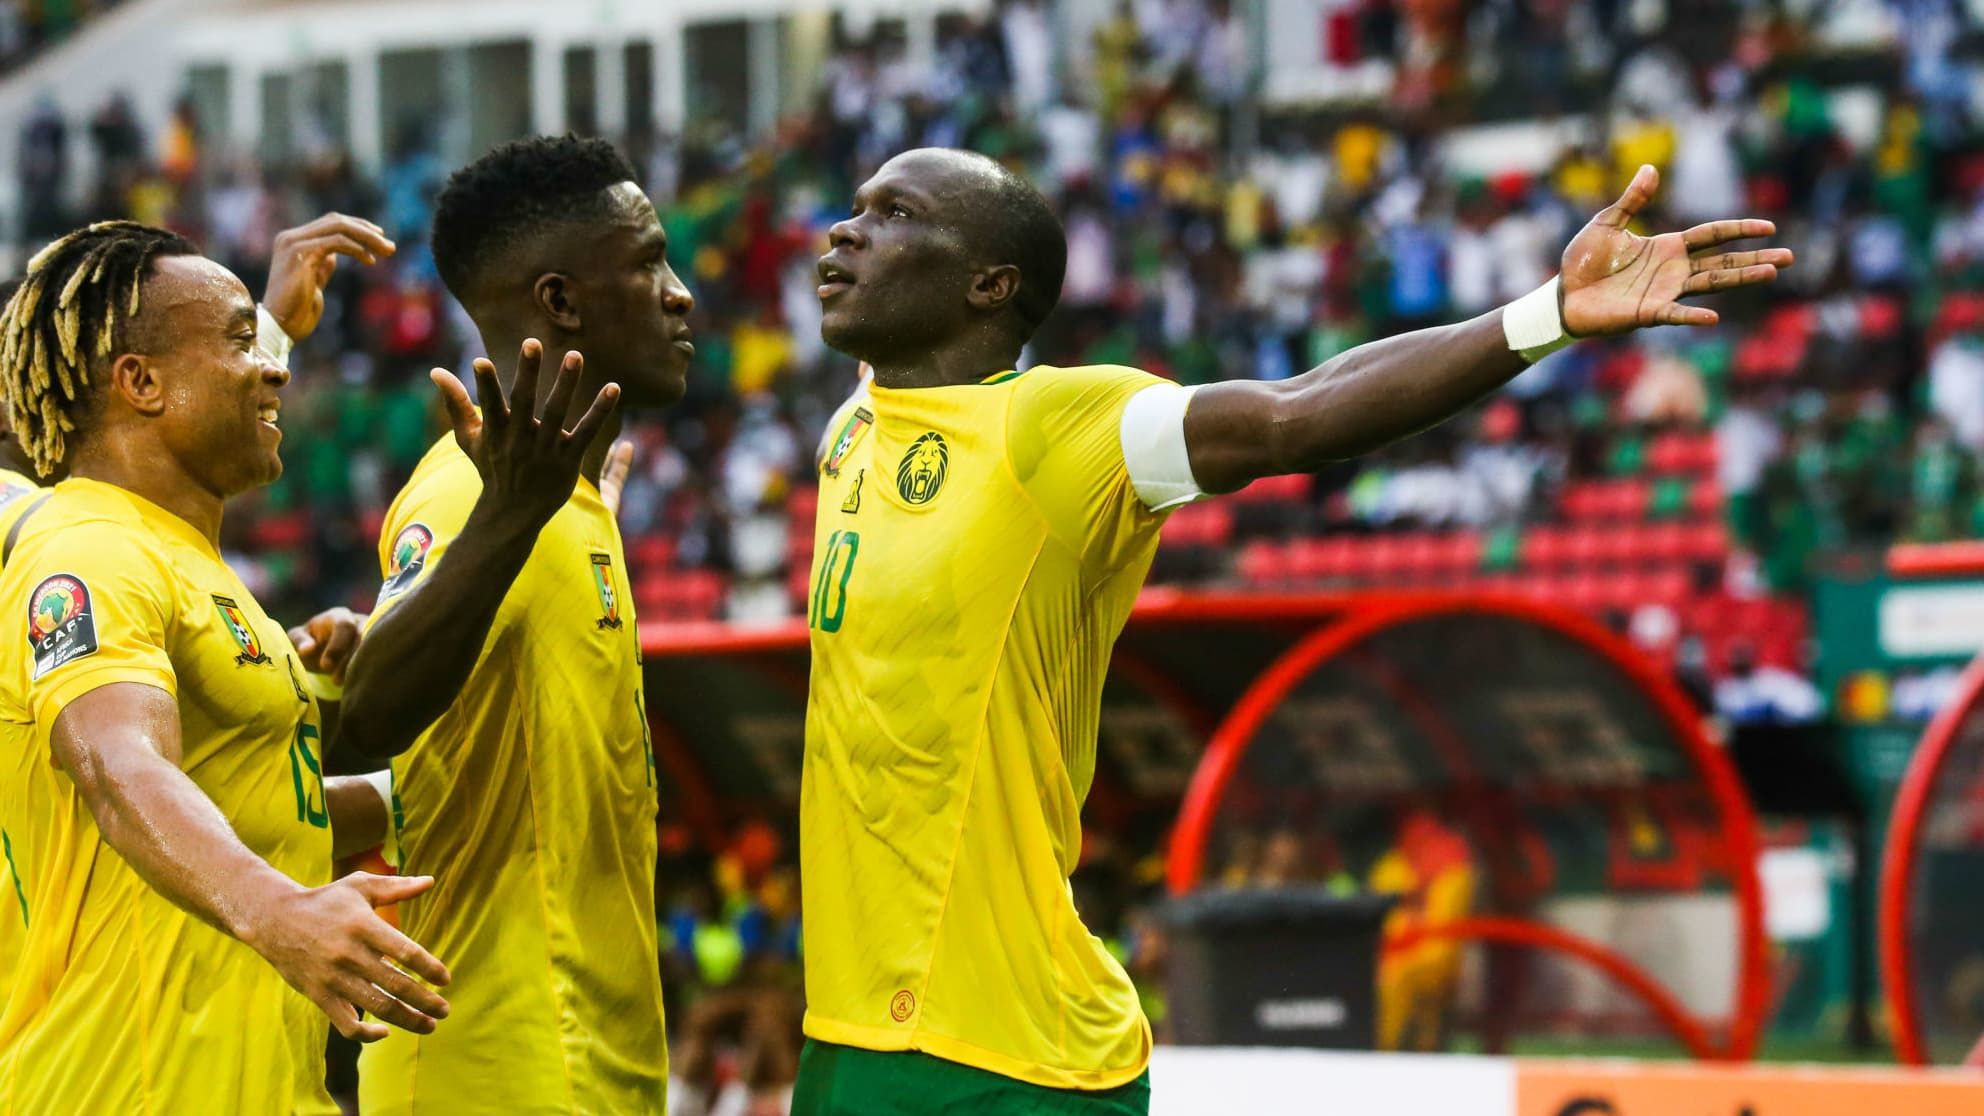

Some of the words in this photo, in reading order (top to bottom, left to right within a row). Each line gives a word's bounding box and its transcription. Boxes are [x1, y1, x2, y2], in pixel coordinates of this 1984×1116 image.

[810, 530, 860, 634] 10
[42, 619, 76, 650] CAF
[289, 722, 329, 829] 15
